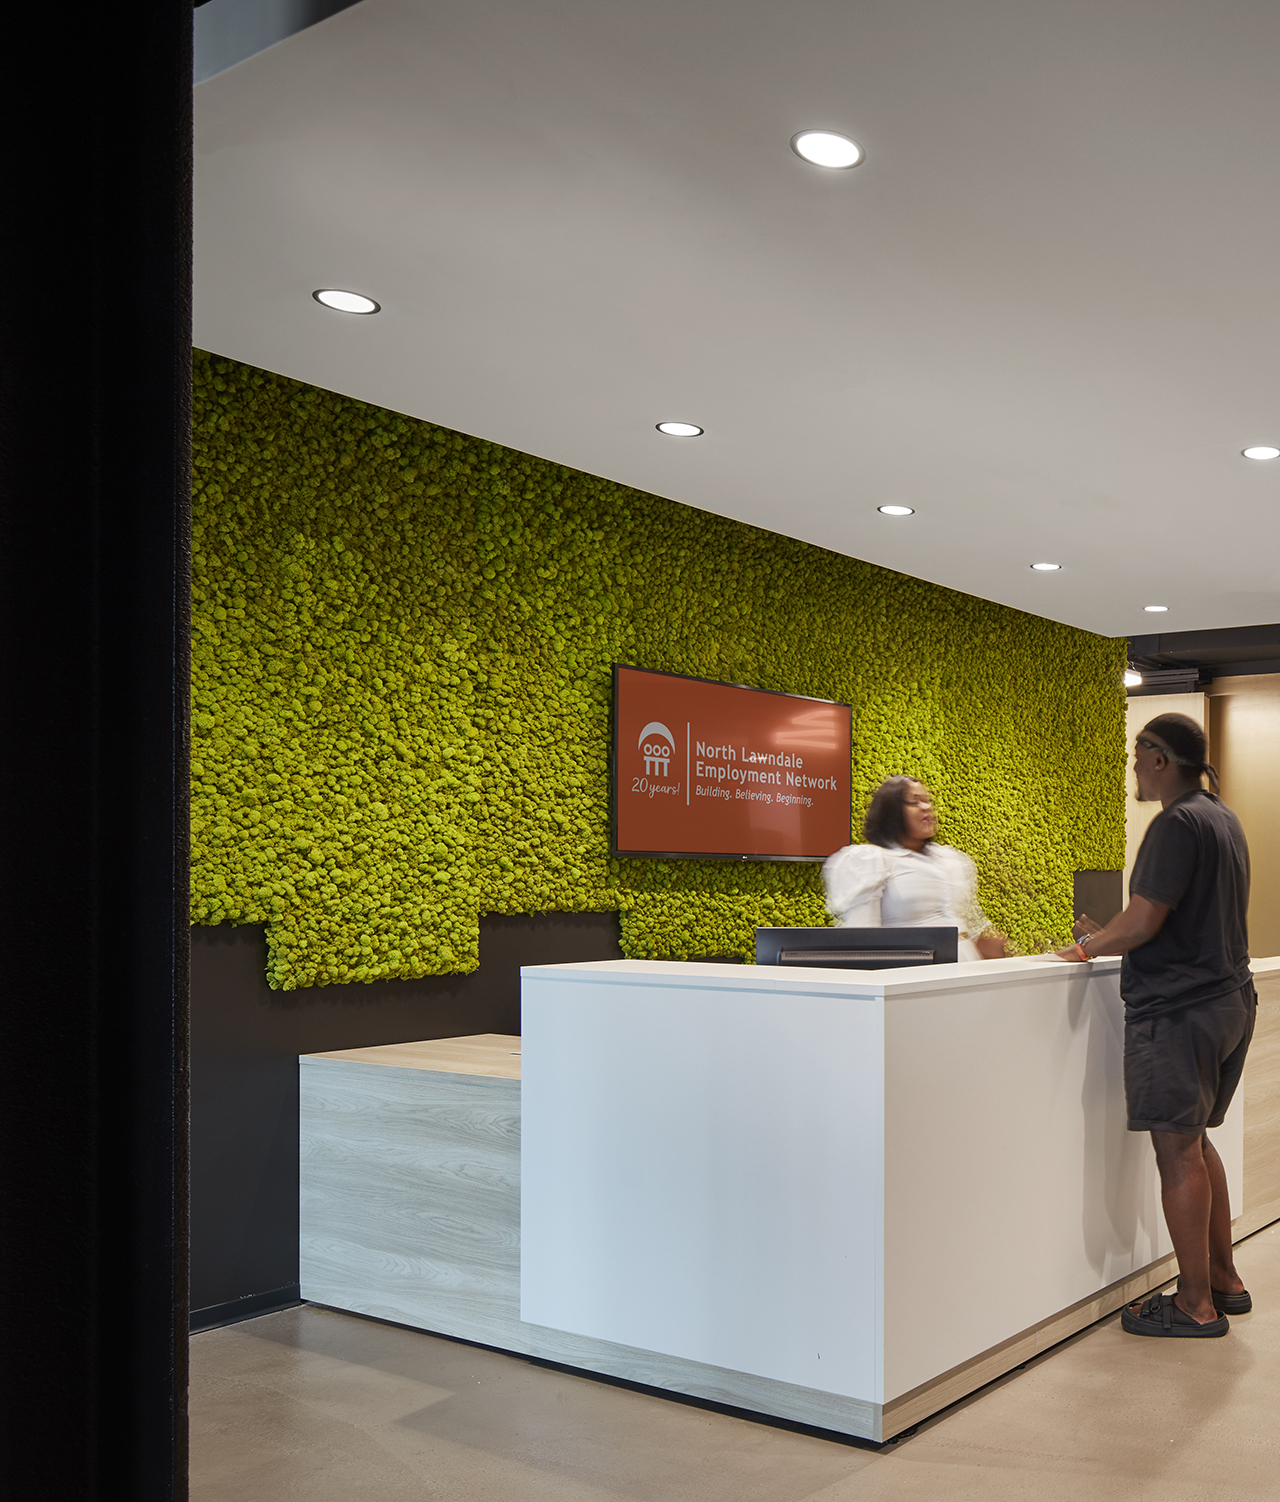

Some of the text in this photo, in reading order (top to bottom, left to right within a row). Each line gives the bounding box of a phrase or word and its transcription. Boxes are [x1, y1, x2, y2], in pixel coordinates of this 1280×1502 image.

[695, 740, 803, 769] North Lawndale
[696, 761, 837, 791] Employment Network
[695, 785, 814, 808] Building. Believing. Beginning.
